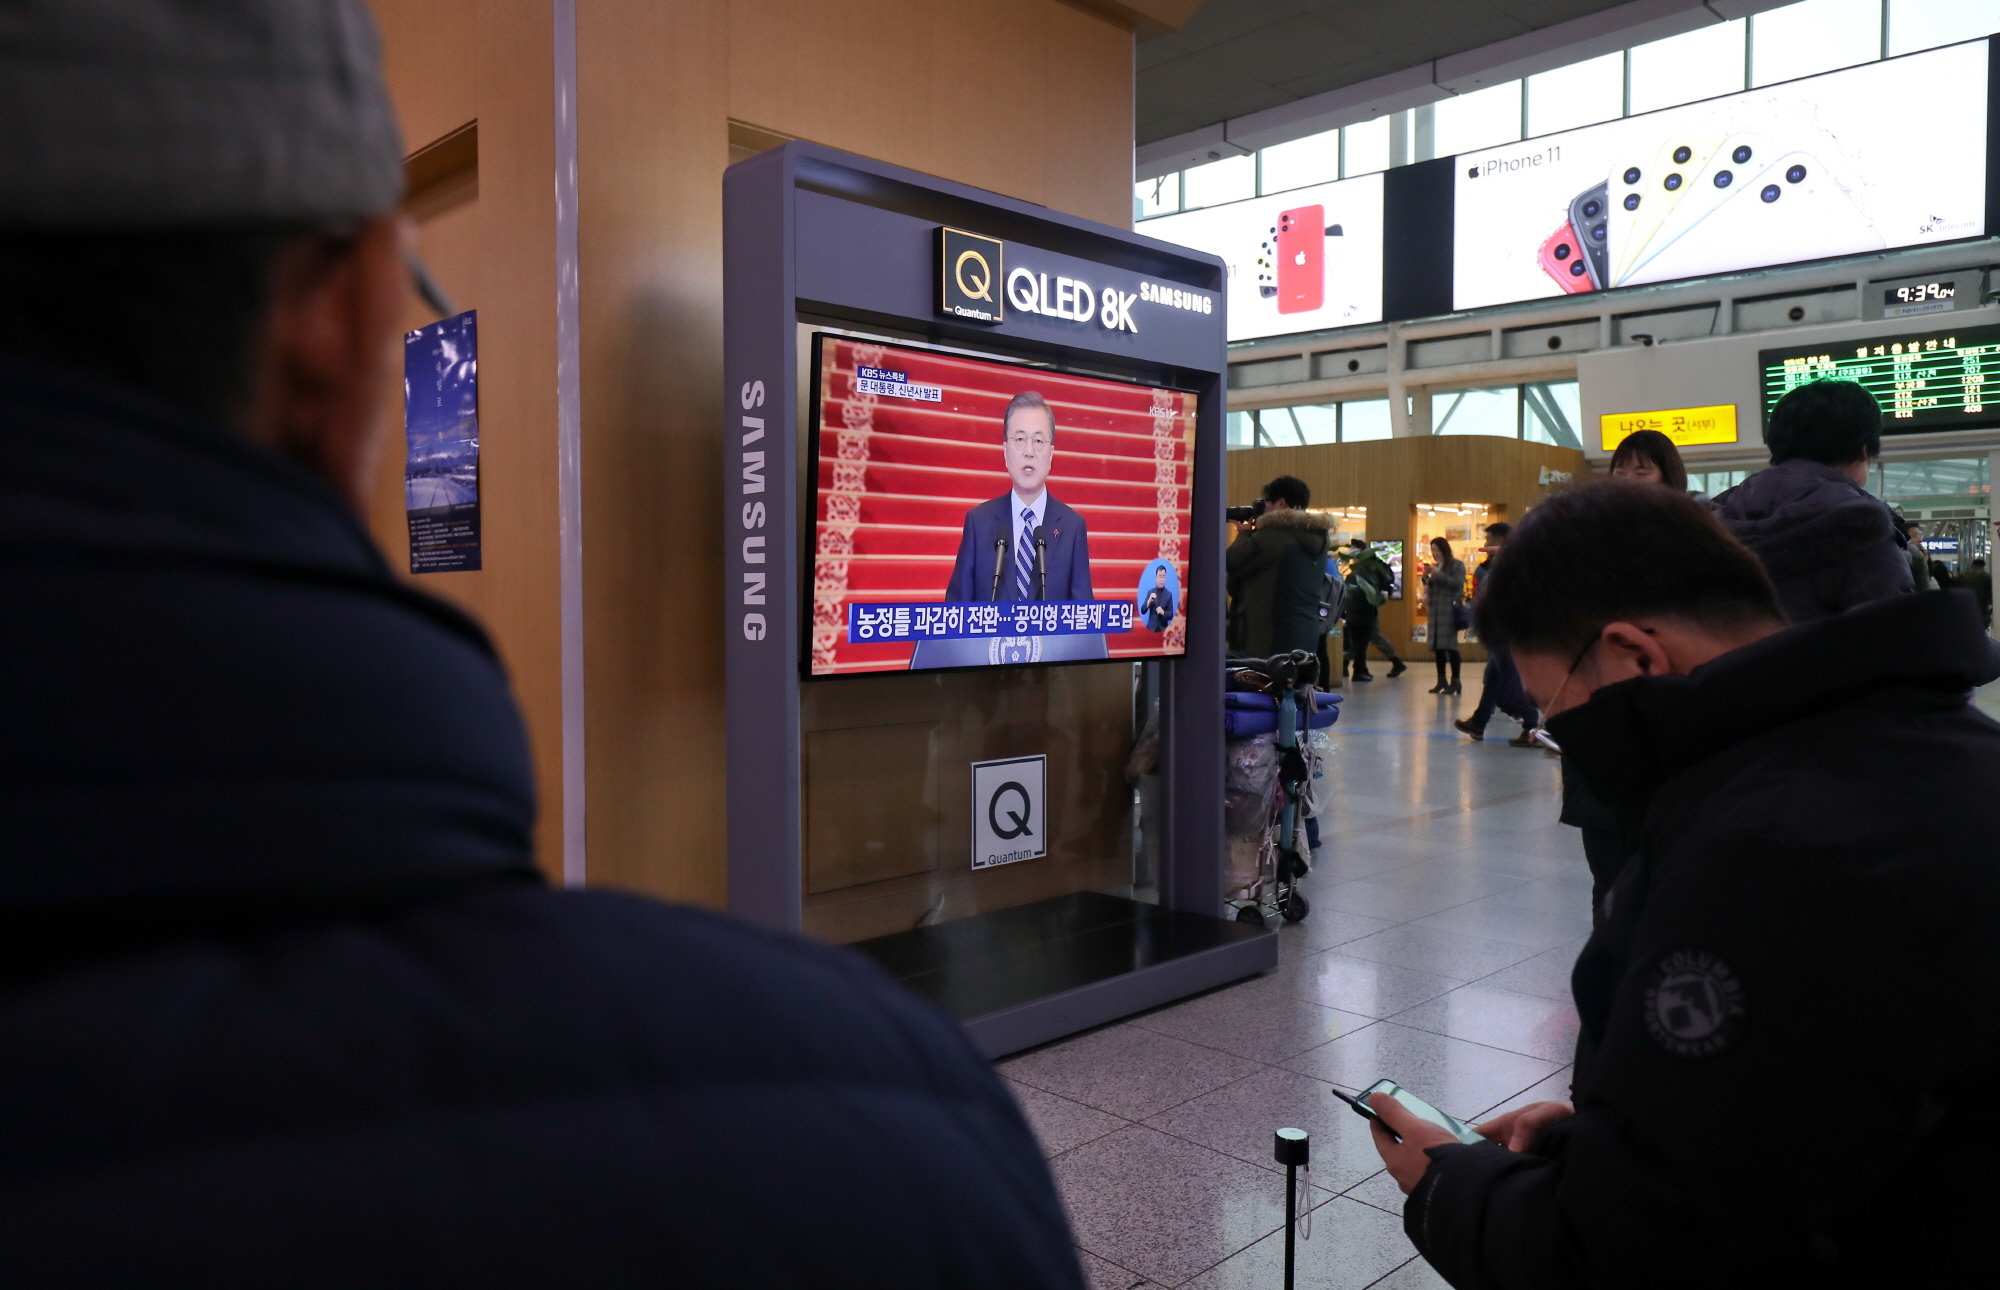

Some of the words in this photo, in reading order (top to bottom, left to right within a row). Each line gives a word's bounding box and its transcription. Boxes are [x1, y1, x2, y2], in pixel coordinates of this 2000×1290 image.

[1482, 154, 1543, 177] iPhone
[1546, 146, 1560, 163] 11
[1919, 224, 1934, 234] SK
[1939, 221, 1976, 232] telecom
[955, 250, 993, 303] Q
[954, 305, 992, 321] Quantum
[1006, 267, 1096, 323] QLED
[1100, 287, 1139, 333] 8K
[1139, 281, 1213, 315] SAMSUNG
[860, 379, 869, 392] 문
[898, 385, 922, 398] 신년사
[923, 387, 939, 400] 발표
[861, 367, 878, 379] KBS
[878, 370, 905, 382] 뉴스특보
[740, 379, 767, 641] SAMSUNG
[856, 604, 910, 639] 농정틀
[914, 605, 964, 635] 과감히
[1106, 603, 1134, 629] 도입
[988, 780, 1034, 840] Q
[988, 849, 1032, 865] Quantum
